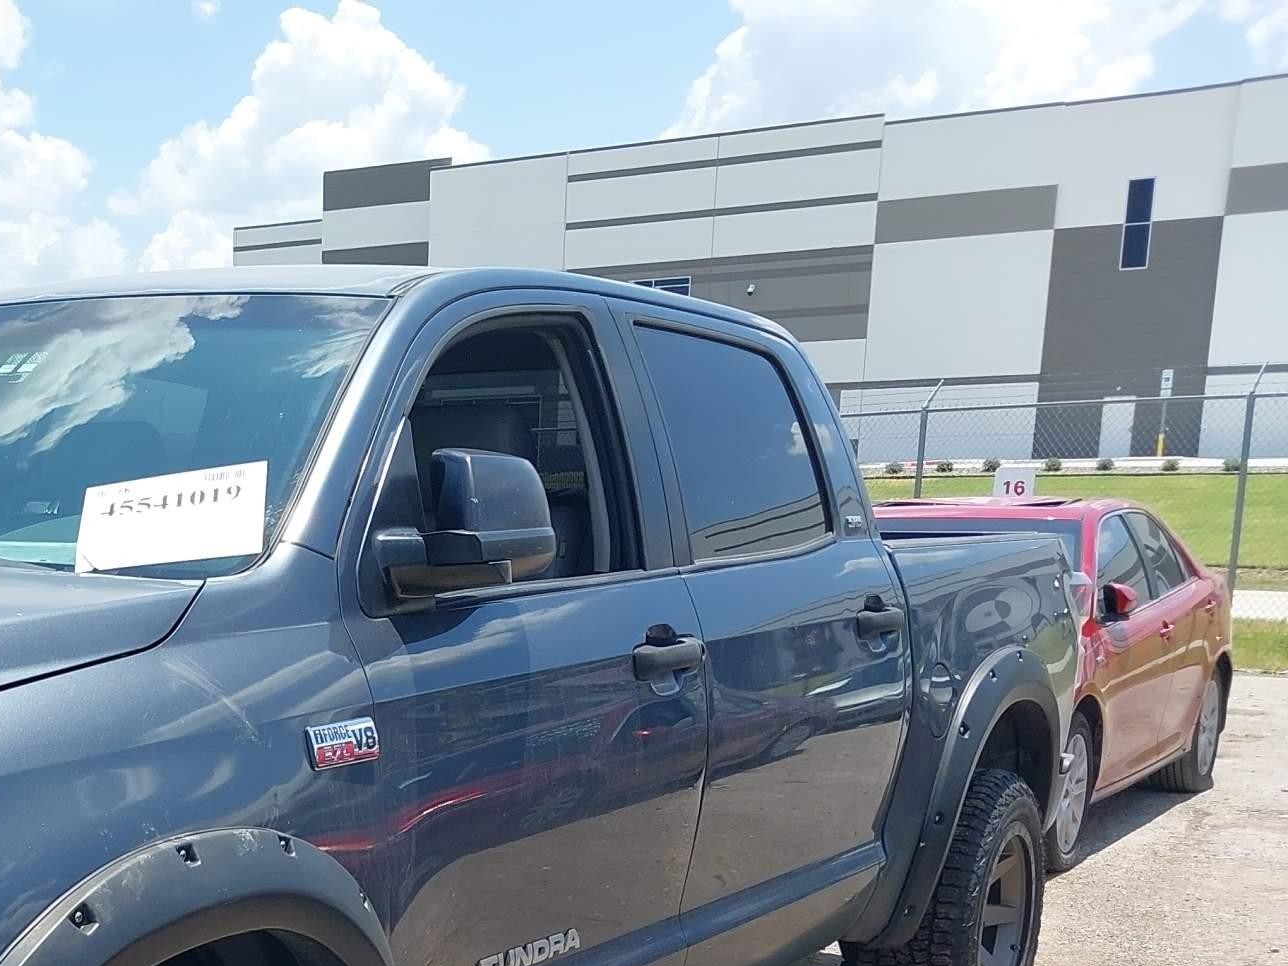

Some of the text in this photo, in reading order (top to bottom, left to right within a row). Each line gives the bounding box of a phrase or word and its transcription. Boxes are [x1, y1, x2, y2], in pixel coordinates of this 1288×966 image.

[101, 485, 242, 517] 45541019
[1003, 480, 1025, 496] 16
[352, 726, 377, 752] V8
